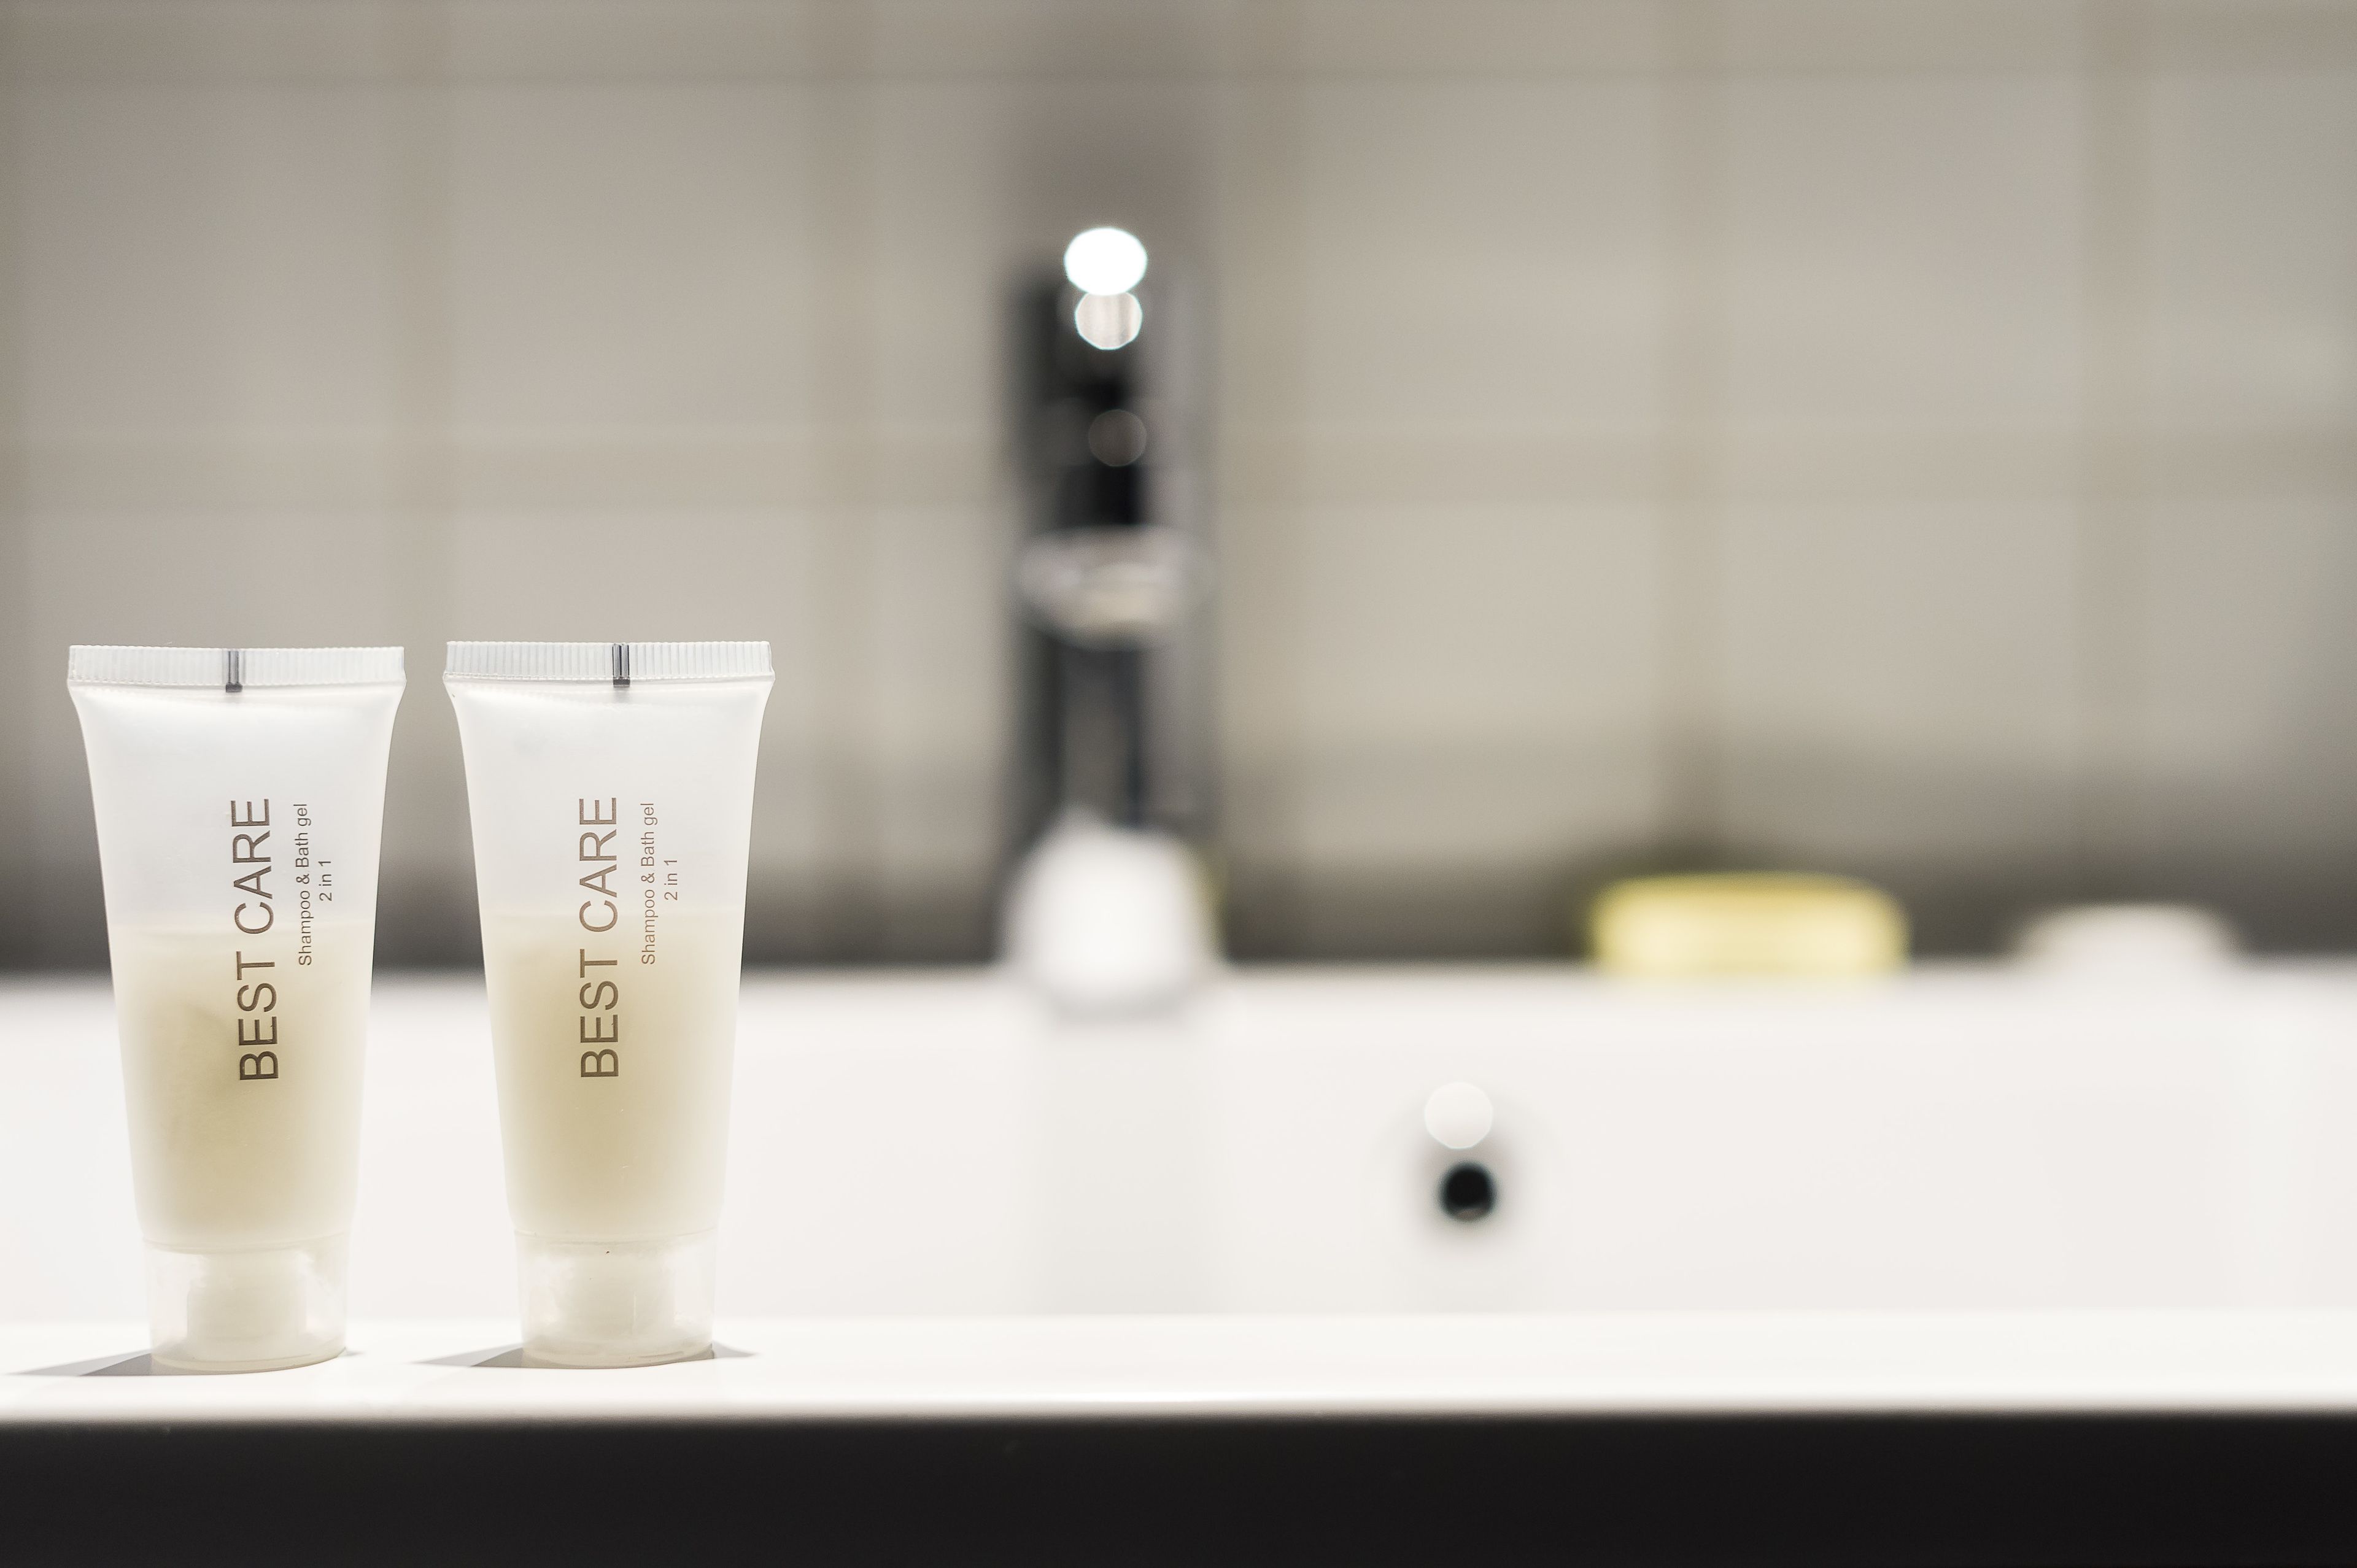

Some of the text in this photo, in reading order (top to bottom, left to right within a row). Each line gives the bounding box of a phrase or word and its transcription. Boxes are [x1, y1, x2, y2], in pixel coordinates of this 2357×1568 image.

[231, 799, 279, 1080] BEST CARE
[293, 805, 314, 965] Shampoo & Bath gel
[319, 875, 331, 886] in
[579, 798, 619, 1077] BEST CARE
[640, 803, 658, 964] Shampoo & Bath gel
[664, 873, 677, 885] in
[664, 892, 677, 900] 2
